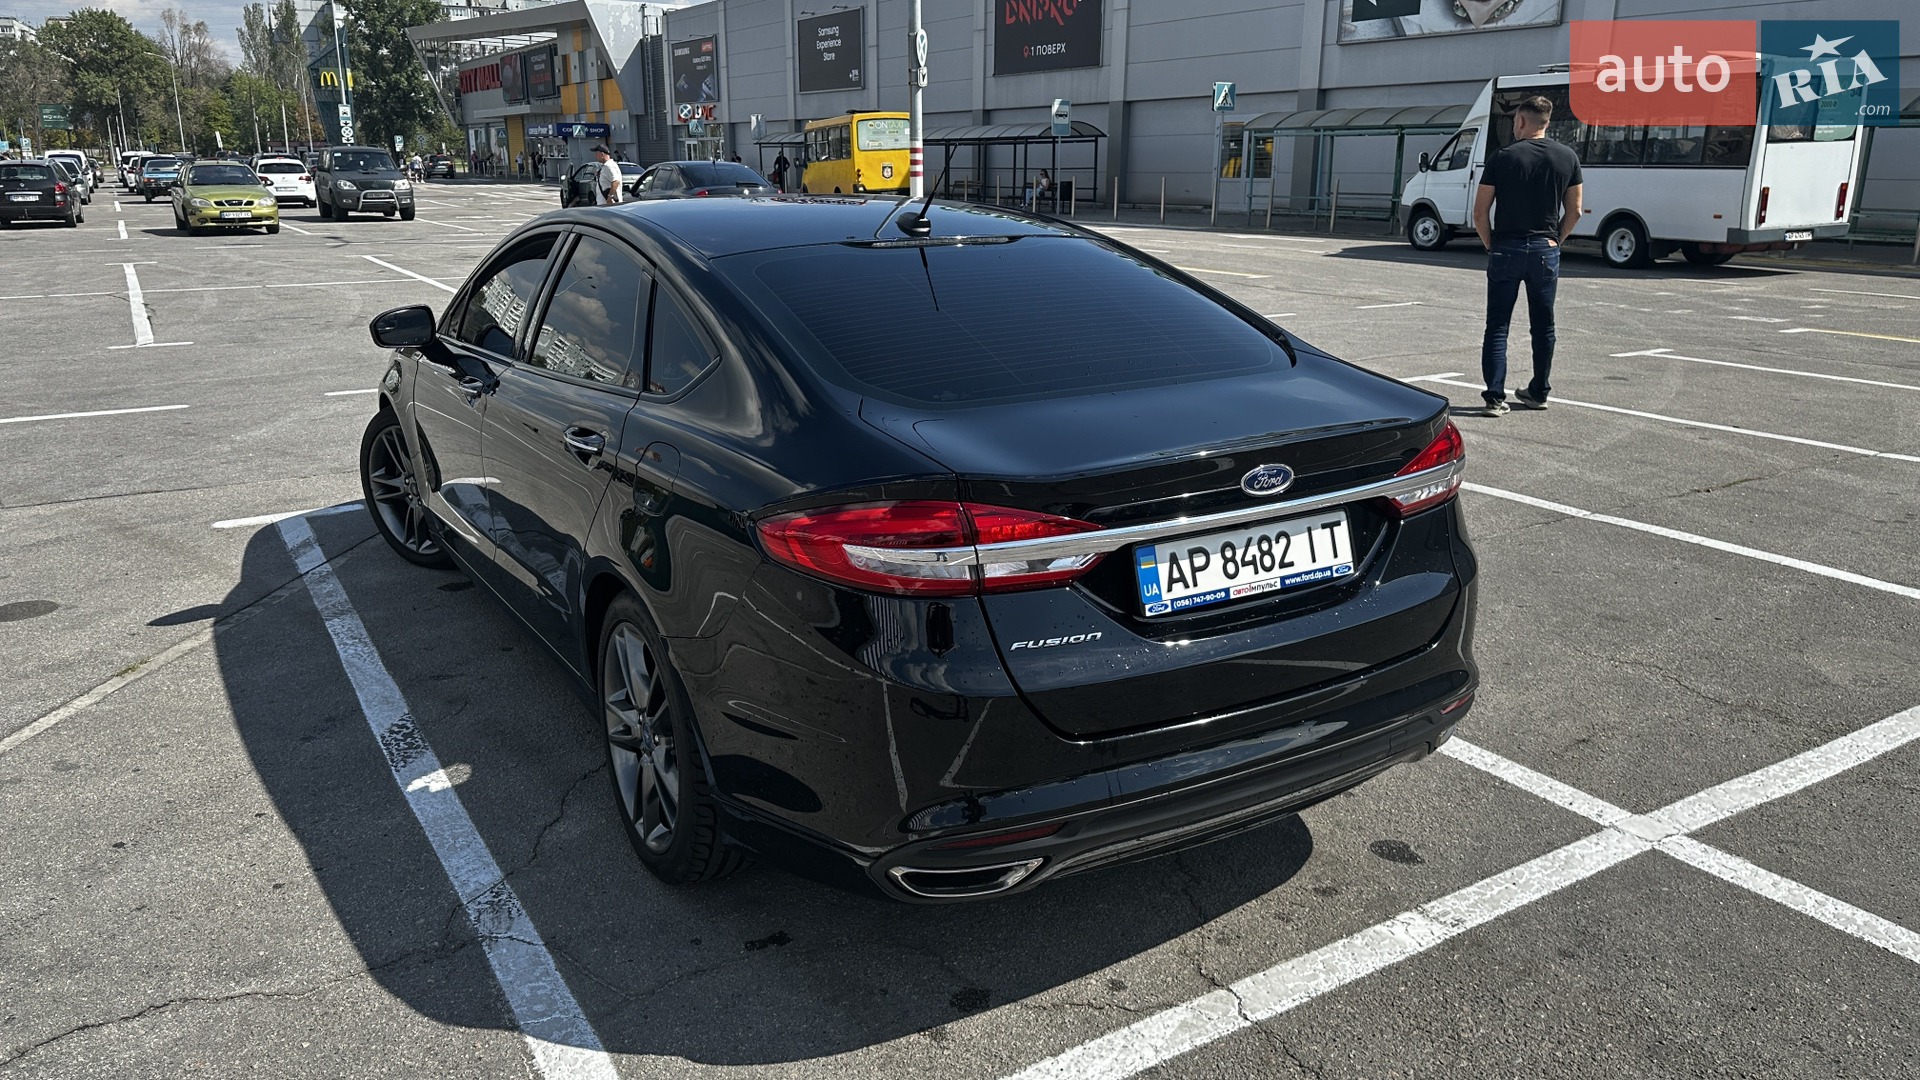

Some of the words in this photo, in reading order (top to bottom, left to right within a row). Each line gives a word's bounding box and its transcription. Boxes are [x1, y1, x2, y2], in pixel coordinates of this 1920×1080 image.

[818, 26, 839, 37] Samsung
[816, 38, 842, 51] Experience
[1036, 42, 1066, 56] ПОВЕРХ
[823, 52, 835, 61] Store
[478, 63, 502, 92] MALL
[1254, 470, 1284, 489] Ford
[1166, 546, 1211, 593] AP
[1220, 530, 1295, 580] 8482
[1284, 569, 1331, 585] www.ford.dp.ua
[1144, 583, 1159, 597] UA
[1173, 597, 1192, 609] (056)
[1193, 591, 1225, 603] 747-90-09
[1009, 631, 1102, 651] FUSION
